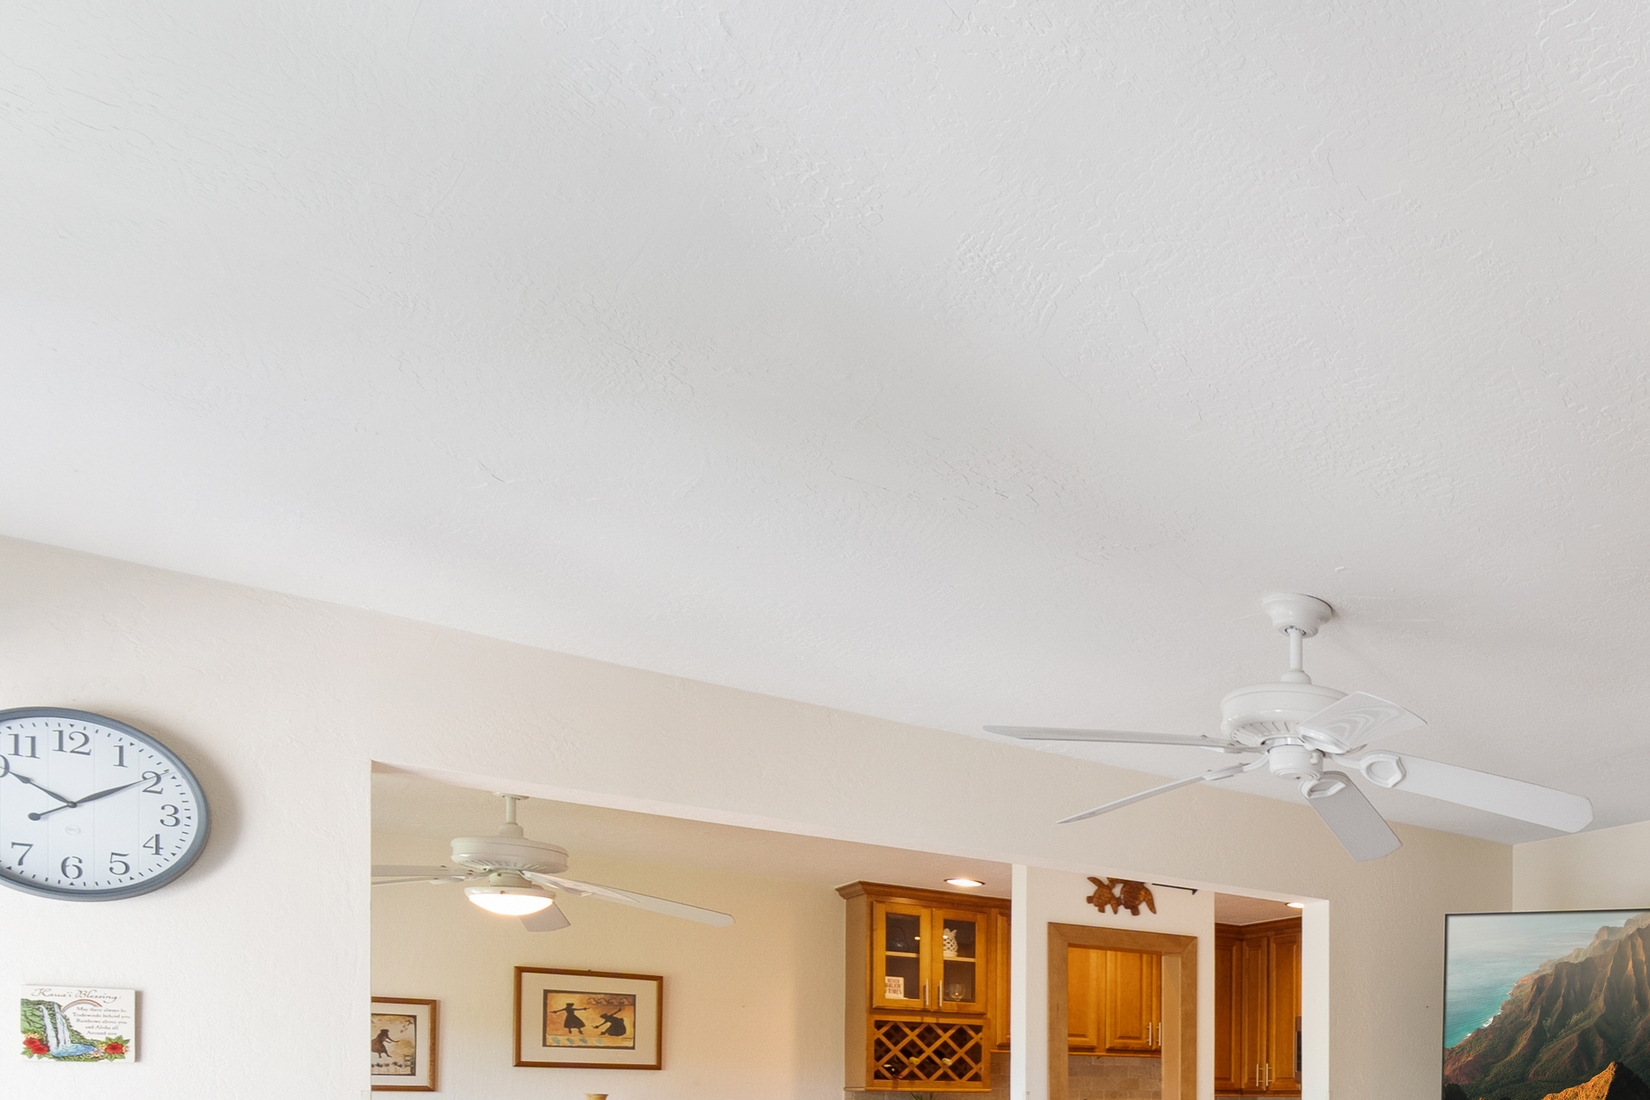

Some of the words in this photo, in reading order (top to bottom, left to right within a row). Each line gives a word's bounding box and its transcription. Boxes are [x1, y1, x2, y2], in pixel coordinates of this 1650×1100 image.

[8, 733, 41, 760] 11
[52, 729, 92, 756] 12
[113, 745, 128, 768] 1
[141, 770, 164, 795] 2
[159, 804, 181, 828] 3
[11, 841, 34, 867] 7
[142, 833, 164, 856] 4
[60, 856, 83, 880] 6
[108, 852, 131, 876] 5
